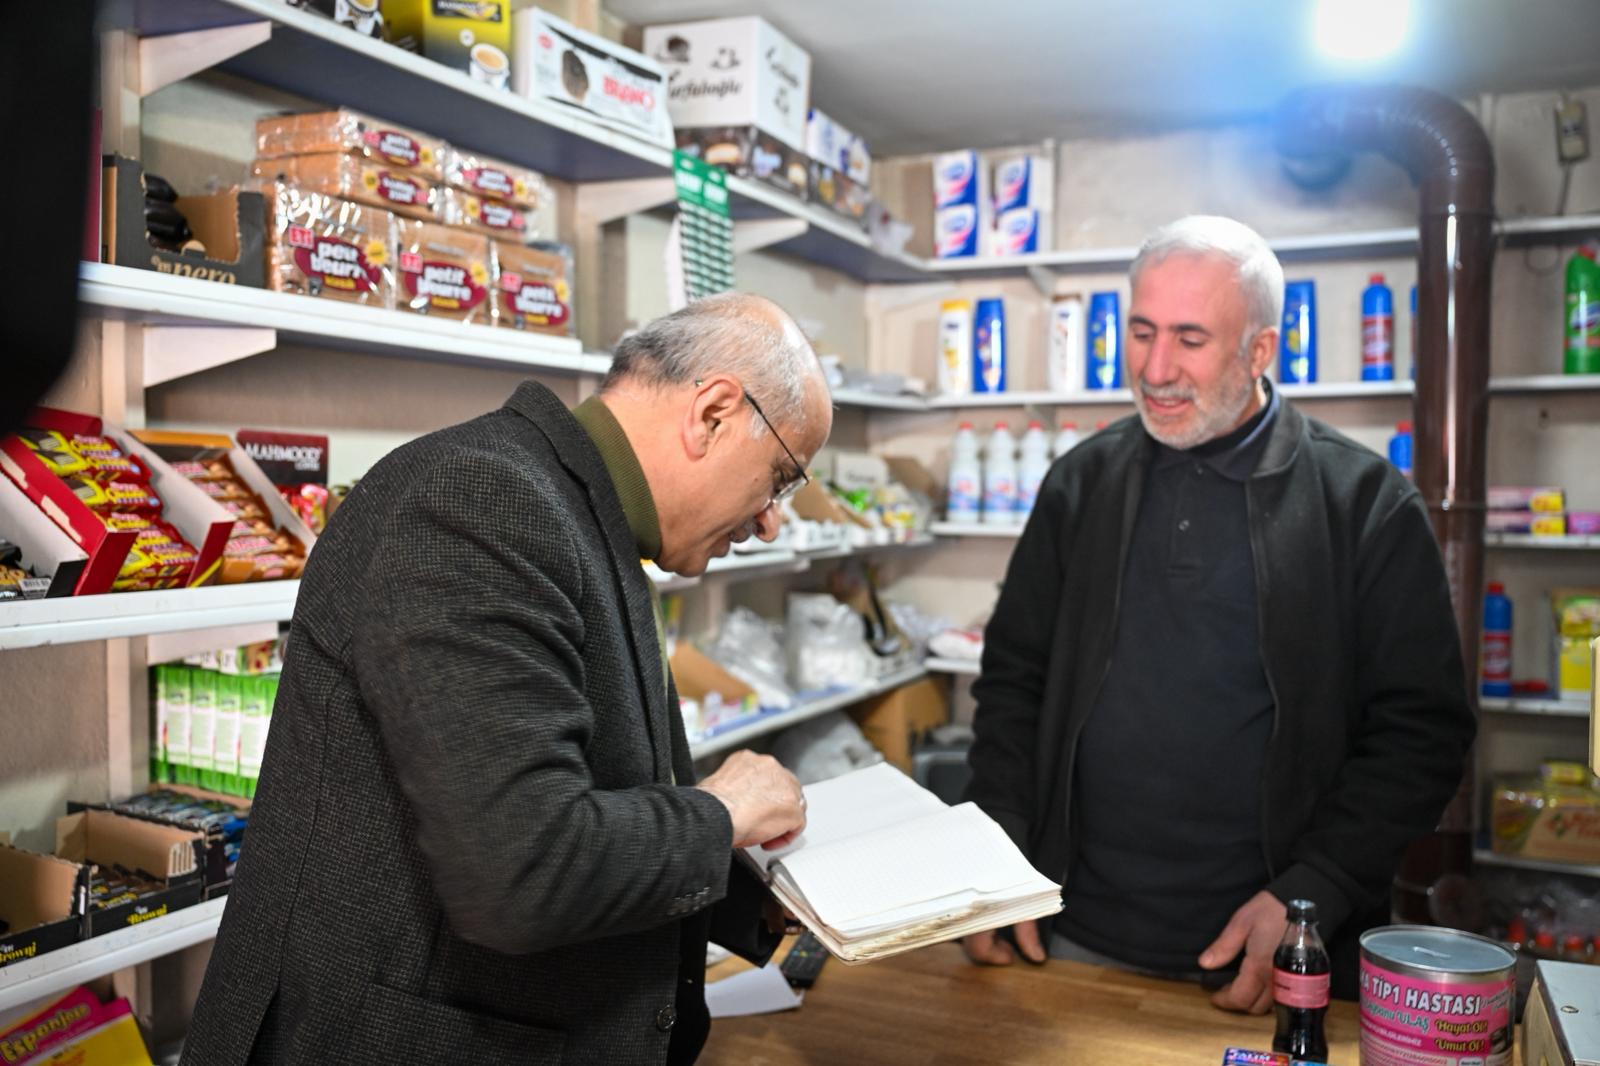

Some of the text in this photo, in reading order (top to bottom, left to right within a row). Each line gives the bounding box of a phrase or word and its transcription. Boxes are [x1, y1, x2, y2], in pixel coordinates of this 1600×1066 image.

[1372, 974, 1400, 1004] TİP1
[1405, 988, 1481, 1015] HASTASI
[1435, 1019, 1470, 1036] Hayat
[1435, 1038, 1467, 1052] Umut
